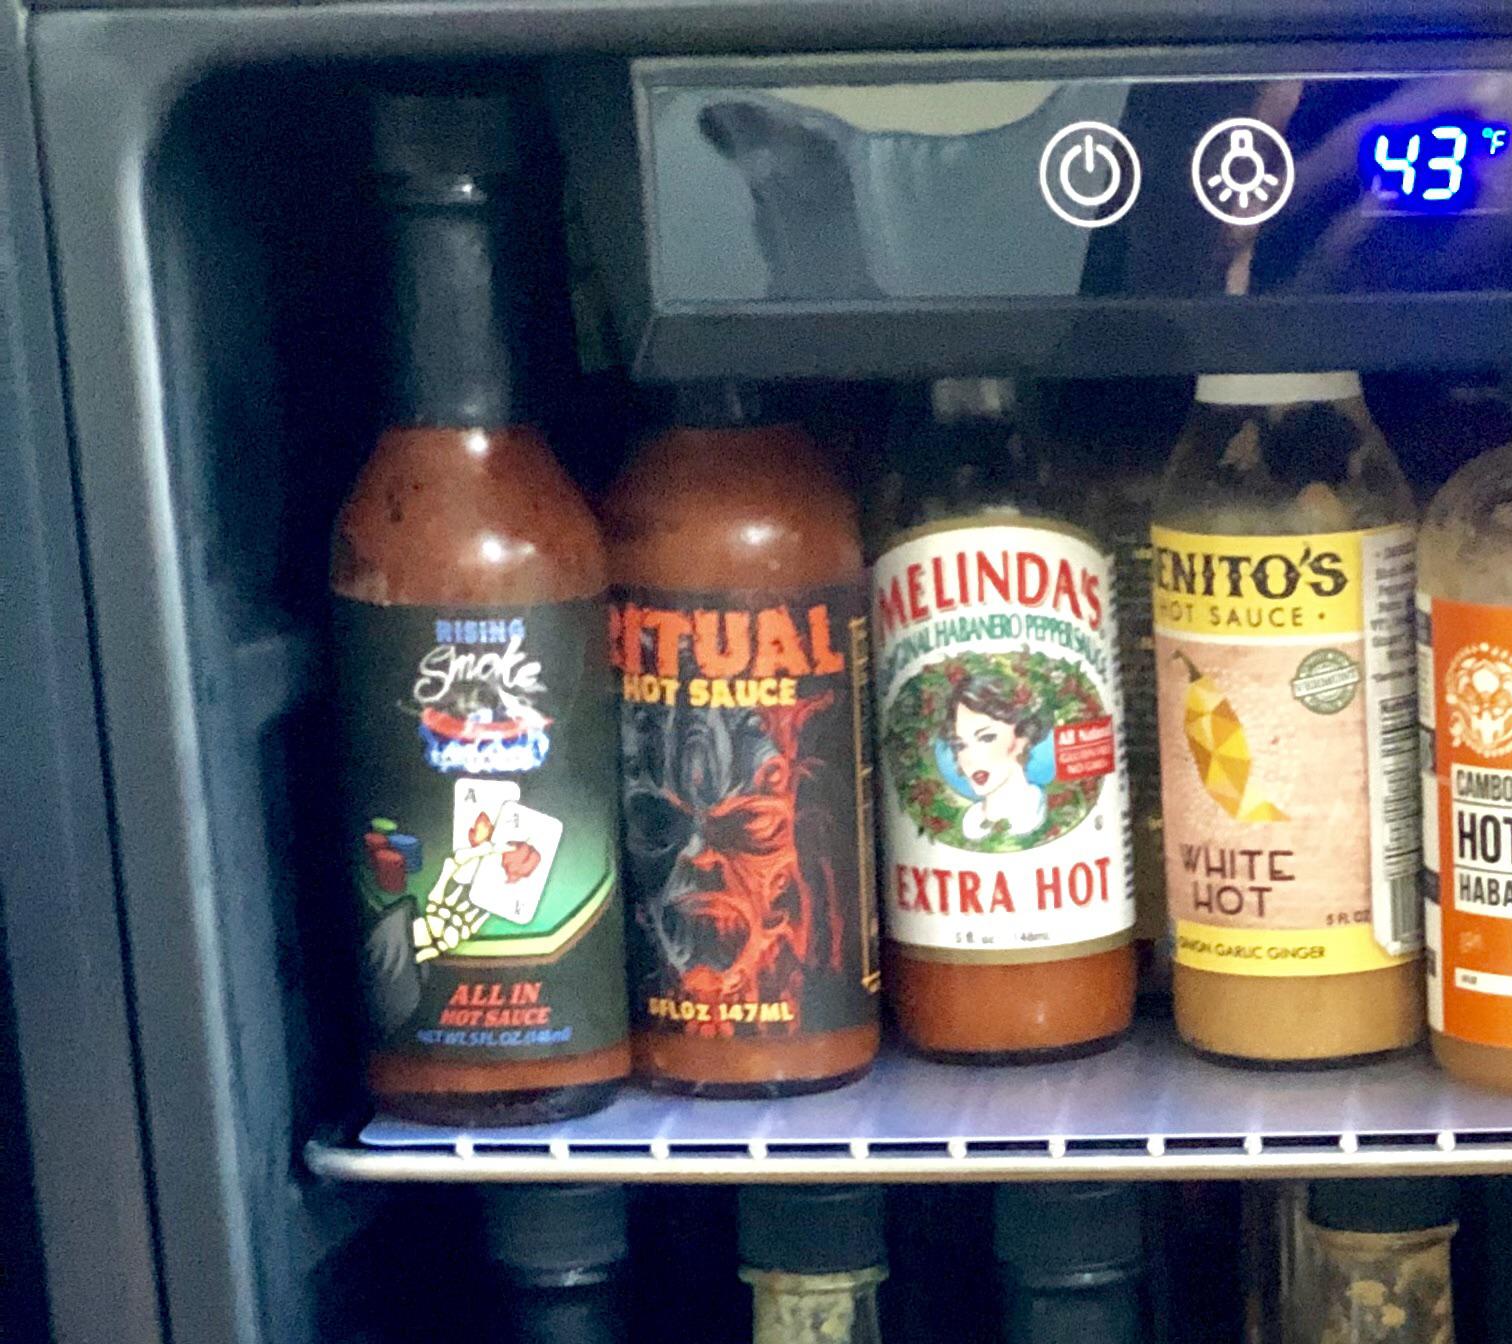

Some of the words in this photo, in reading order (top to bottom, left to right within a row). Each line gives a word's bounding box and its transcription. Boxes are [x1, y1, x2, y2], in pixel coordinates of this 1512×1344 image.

[1376, 125, 1468, 201] 43
[1156, 542, 1349, 599] ENITO'S
[878, 550, 1104, 634] MELINDA'S
[435, 619, 525, 645] RISING
[934, 613, 1022, 648] HABANERO
[1024, 614, 1073, 648] PEPPER
[1209, 605, 1304, 629] SAUCE
[623, 675, 679, 707] HOT
[689, 677, 798, 708] SAUCE
[1180, 844, 1296, 883] WHITE
[894, 864, 1016, 915] EXTRA
[1035, 857, 1111, 912] HOT
[1193, 884, 1272, 919] HOT
[1214, 943, 1264, 961] GARLIC
[1267, 944, 1326, 962] GINGER
[449, 982, 506, 1006] ALL
[511, 981, 542, 1006] IN
[440, 1008, 483, 1028] HOT
[485, 1005, 551, 1026] SAUCE
